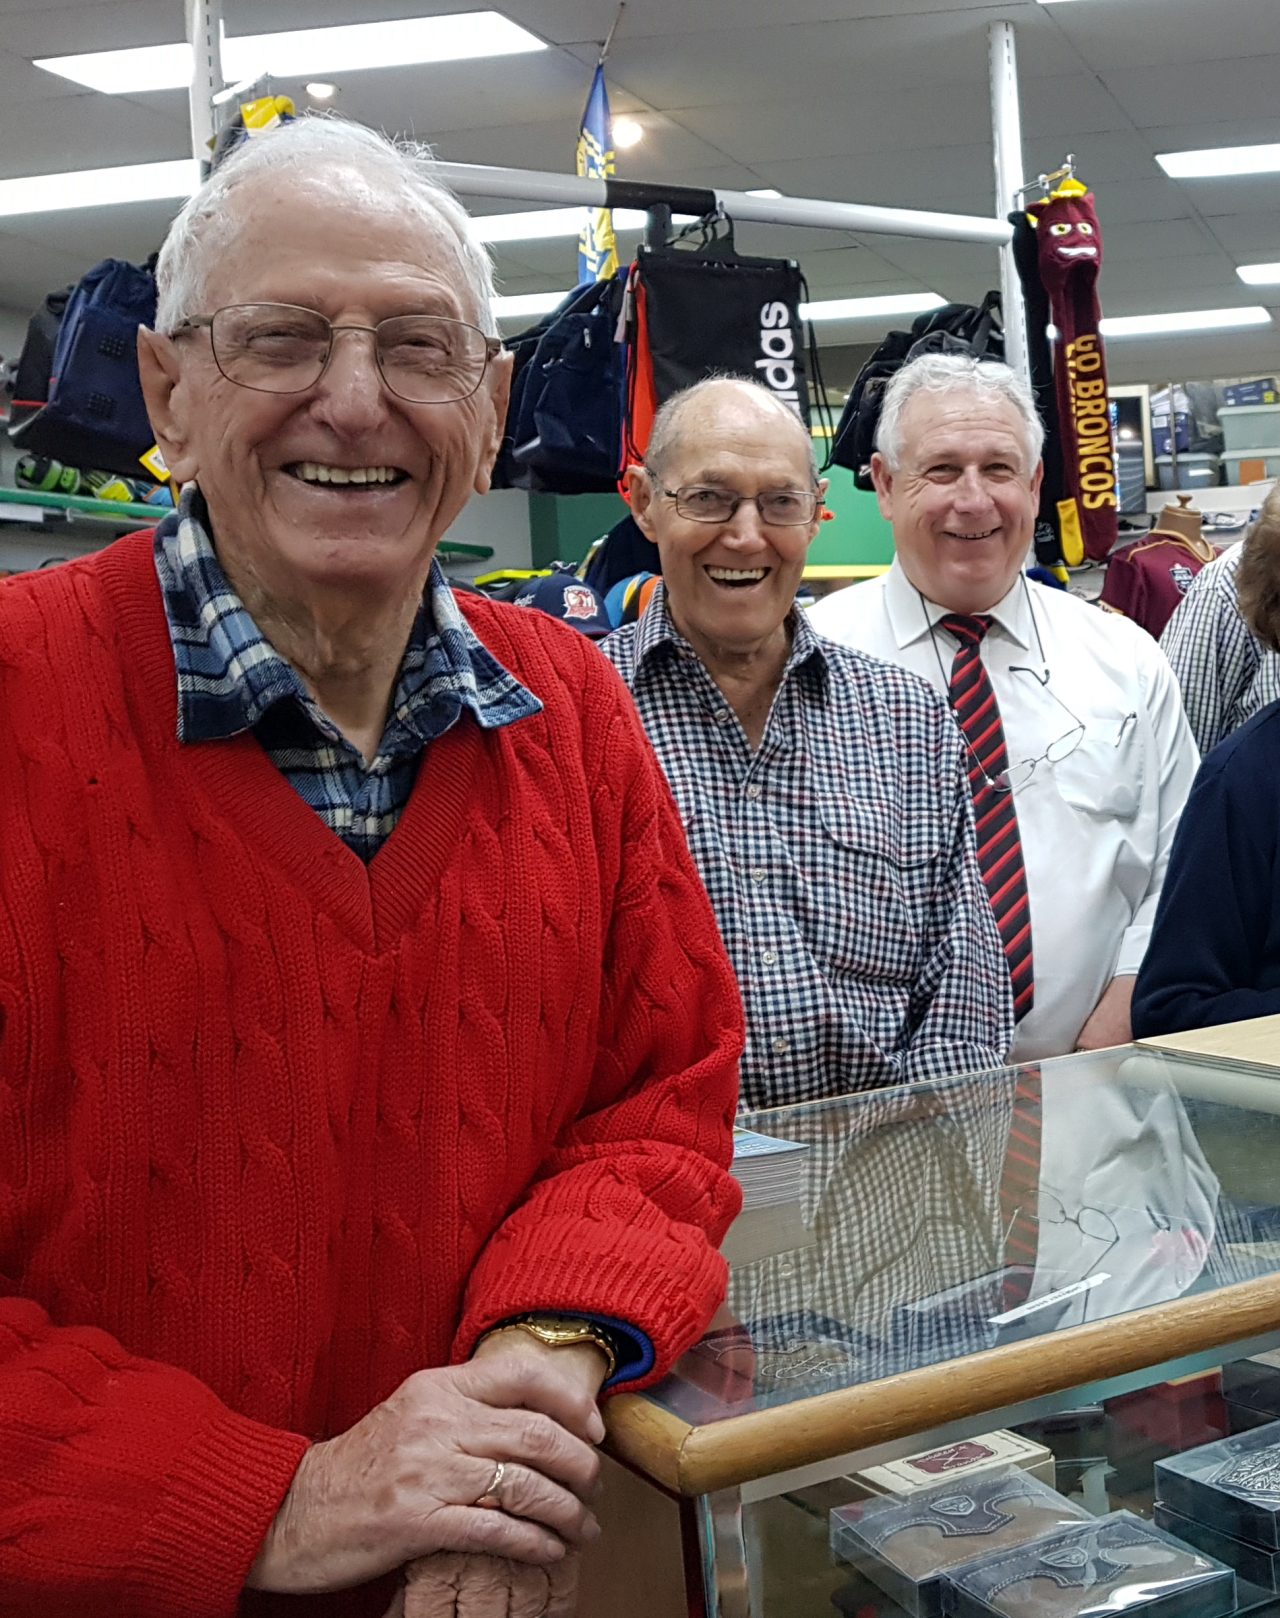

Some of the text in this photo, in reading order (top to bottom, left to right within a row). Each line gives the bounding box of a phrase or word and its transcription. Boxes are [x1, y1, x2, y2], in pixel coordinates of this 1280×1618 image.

[755, 301, 799, 416] idas
[1074, 334, 1116, 510] GO BRONCOS
